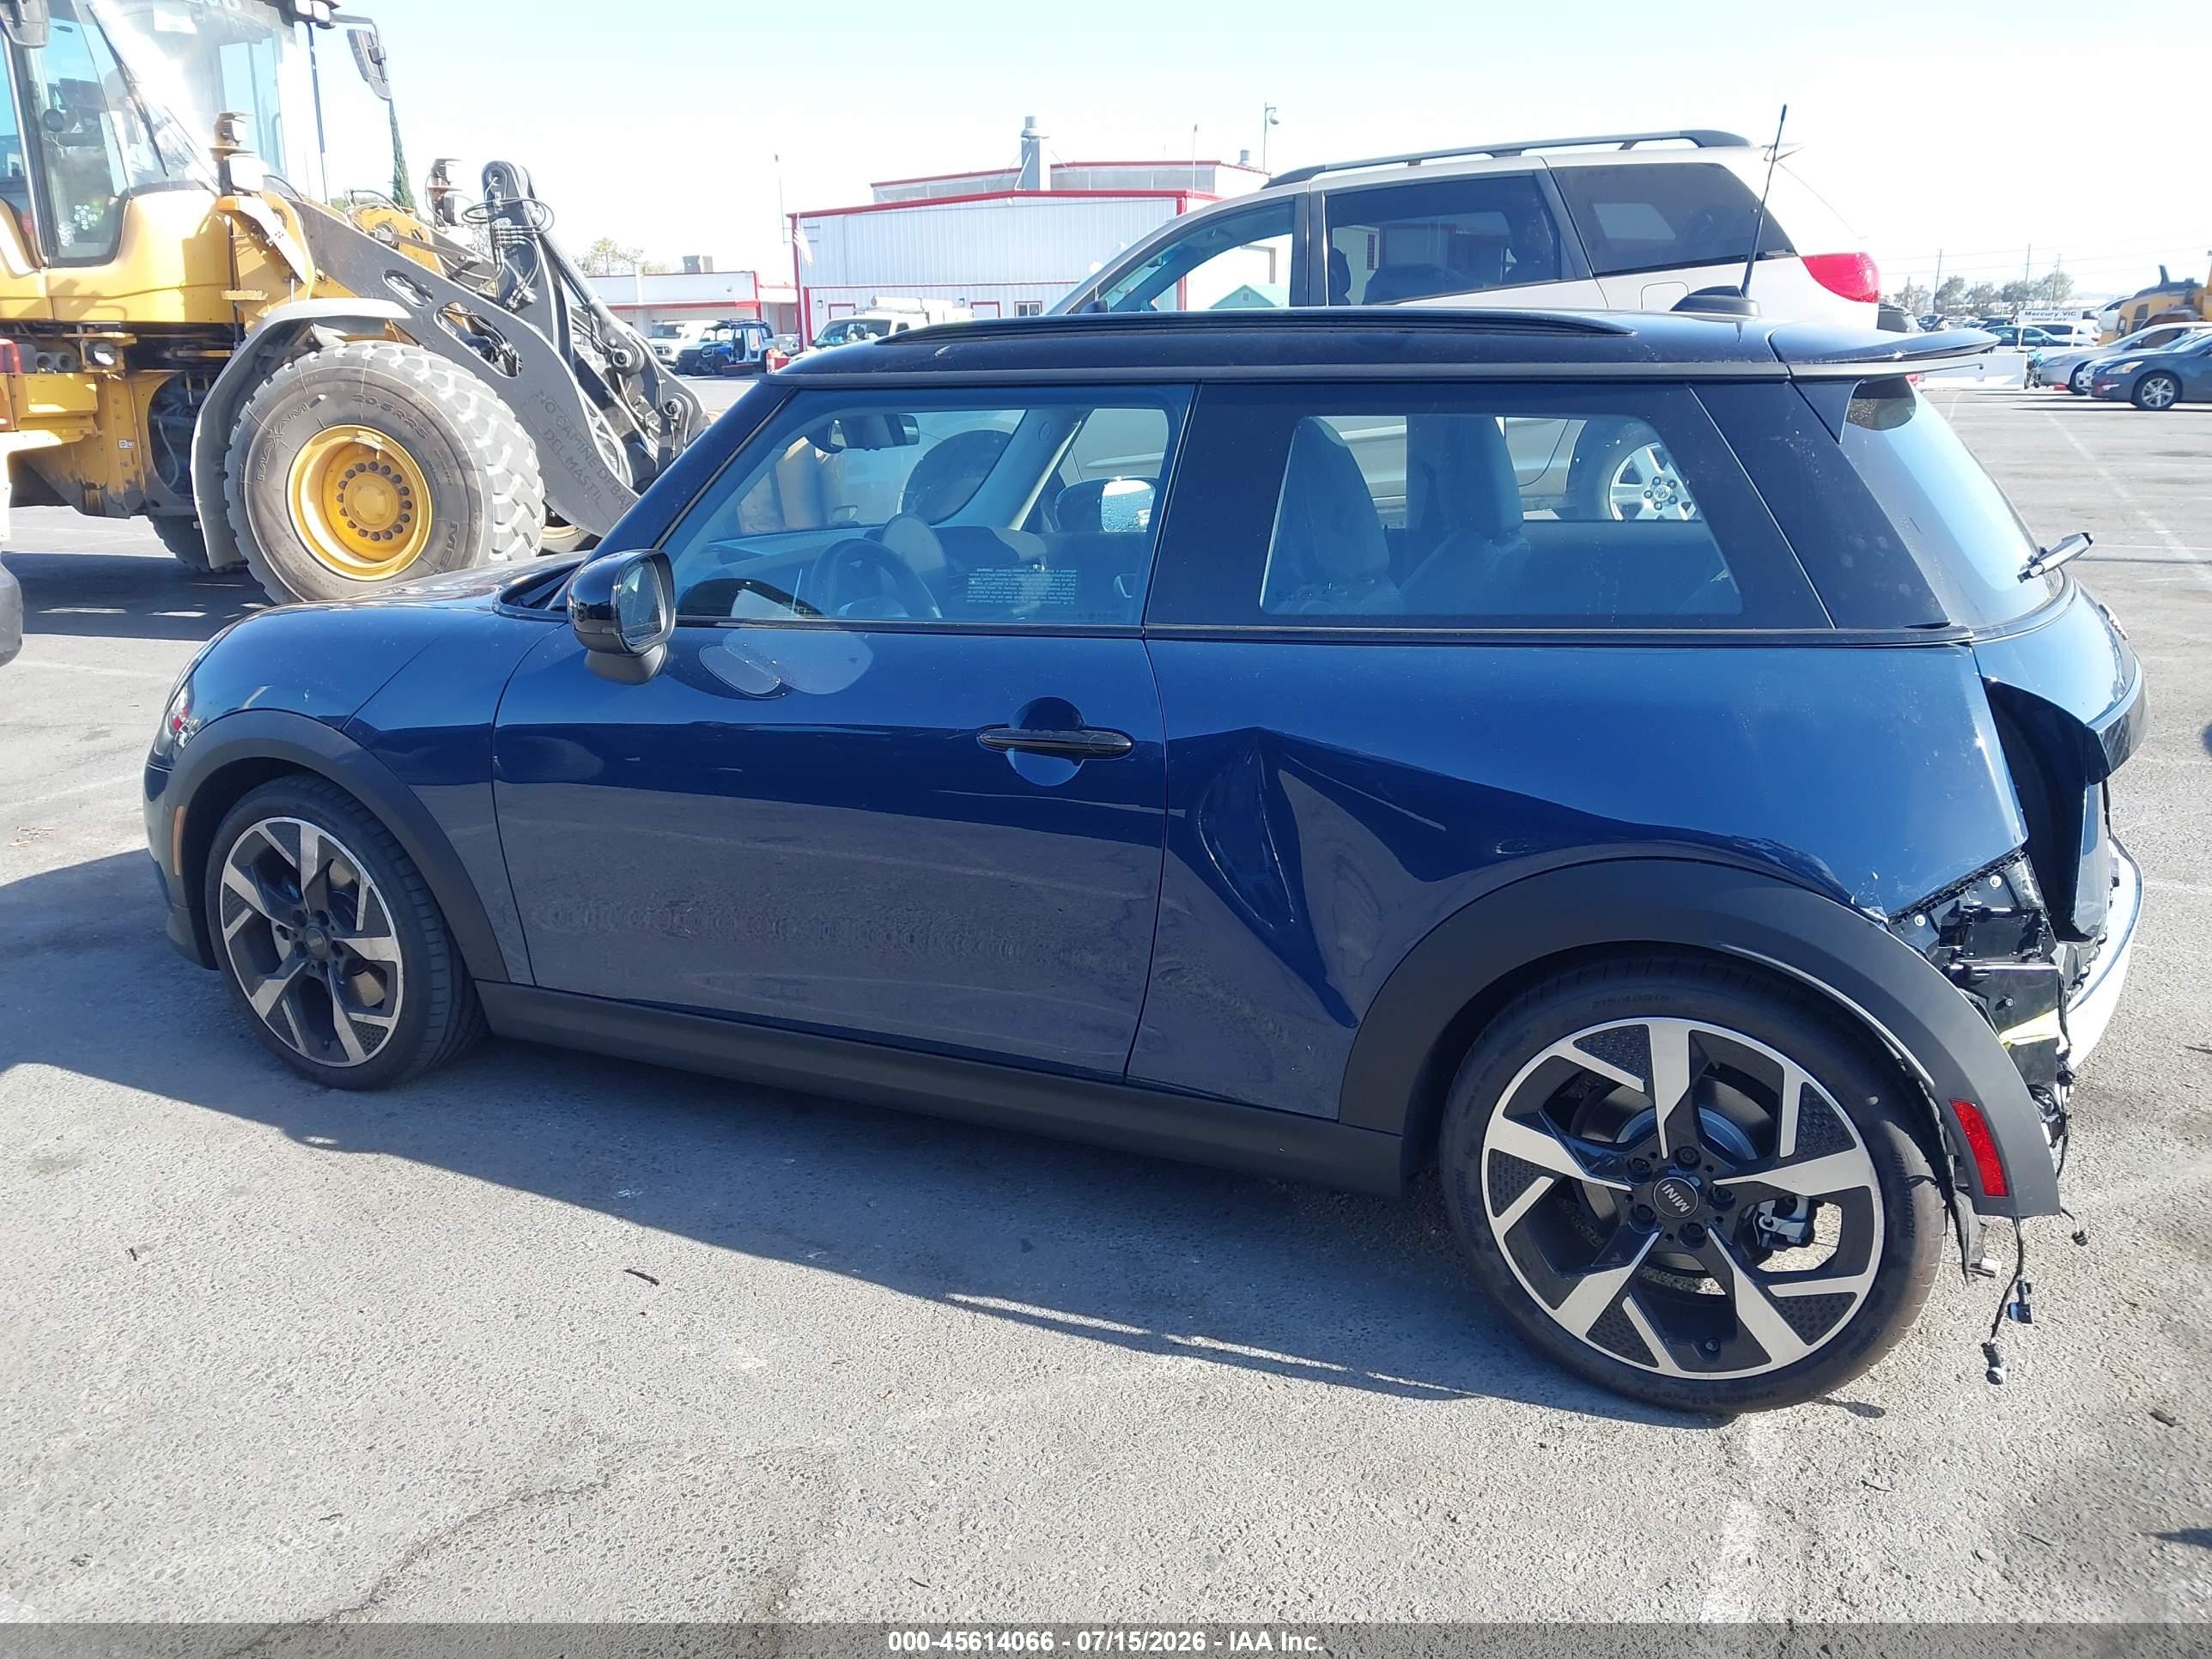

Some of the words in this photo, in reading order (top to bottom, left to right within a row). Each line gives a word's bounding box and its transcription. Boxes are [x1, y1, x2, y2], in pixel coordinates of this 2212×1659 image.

[543, 429, 566, 457] DEL
[556, 415, 599, 468] CAMINE
[1662, 1183, 1690, 1212] MINI
